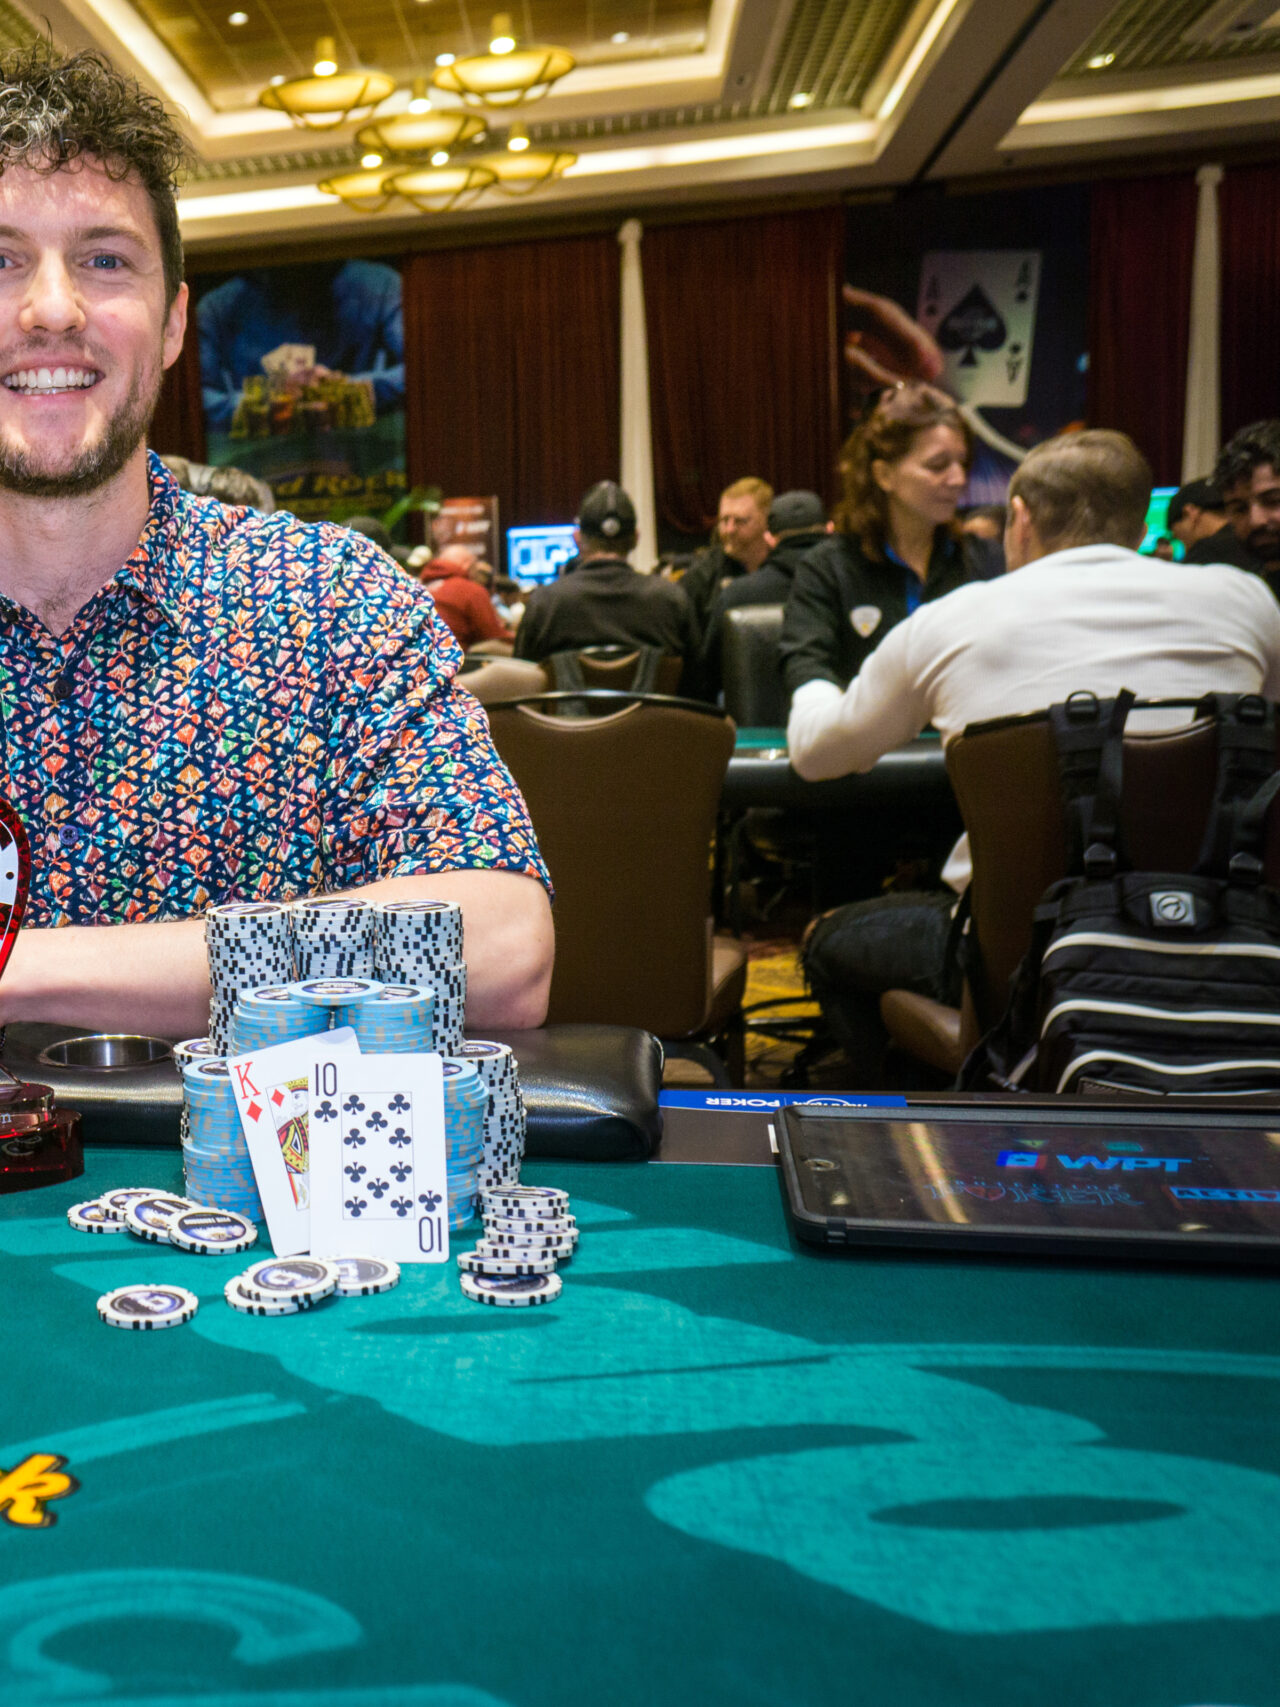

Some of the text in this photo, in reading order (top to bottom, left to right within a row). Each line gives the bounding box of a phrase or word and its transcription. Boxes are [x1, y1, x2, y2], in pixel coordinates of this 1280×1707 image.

[234, 1061, 261, 1100] K
[315, 1062, 337, 1097] 10
[1056, 1154, 1192, 1173] WPT
